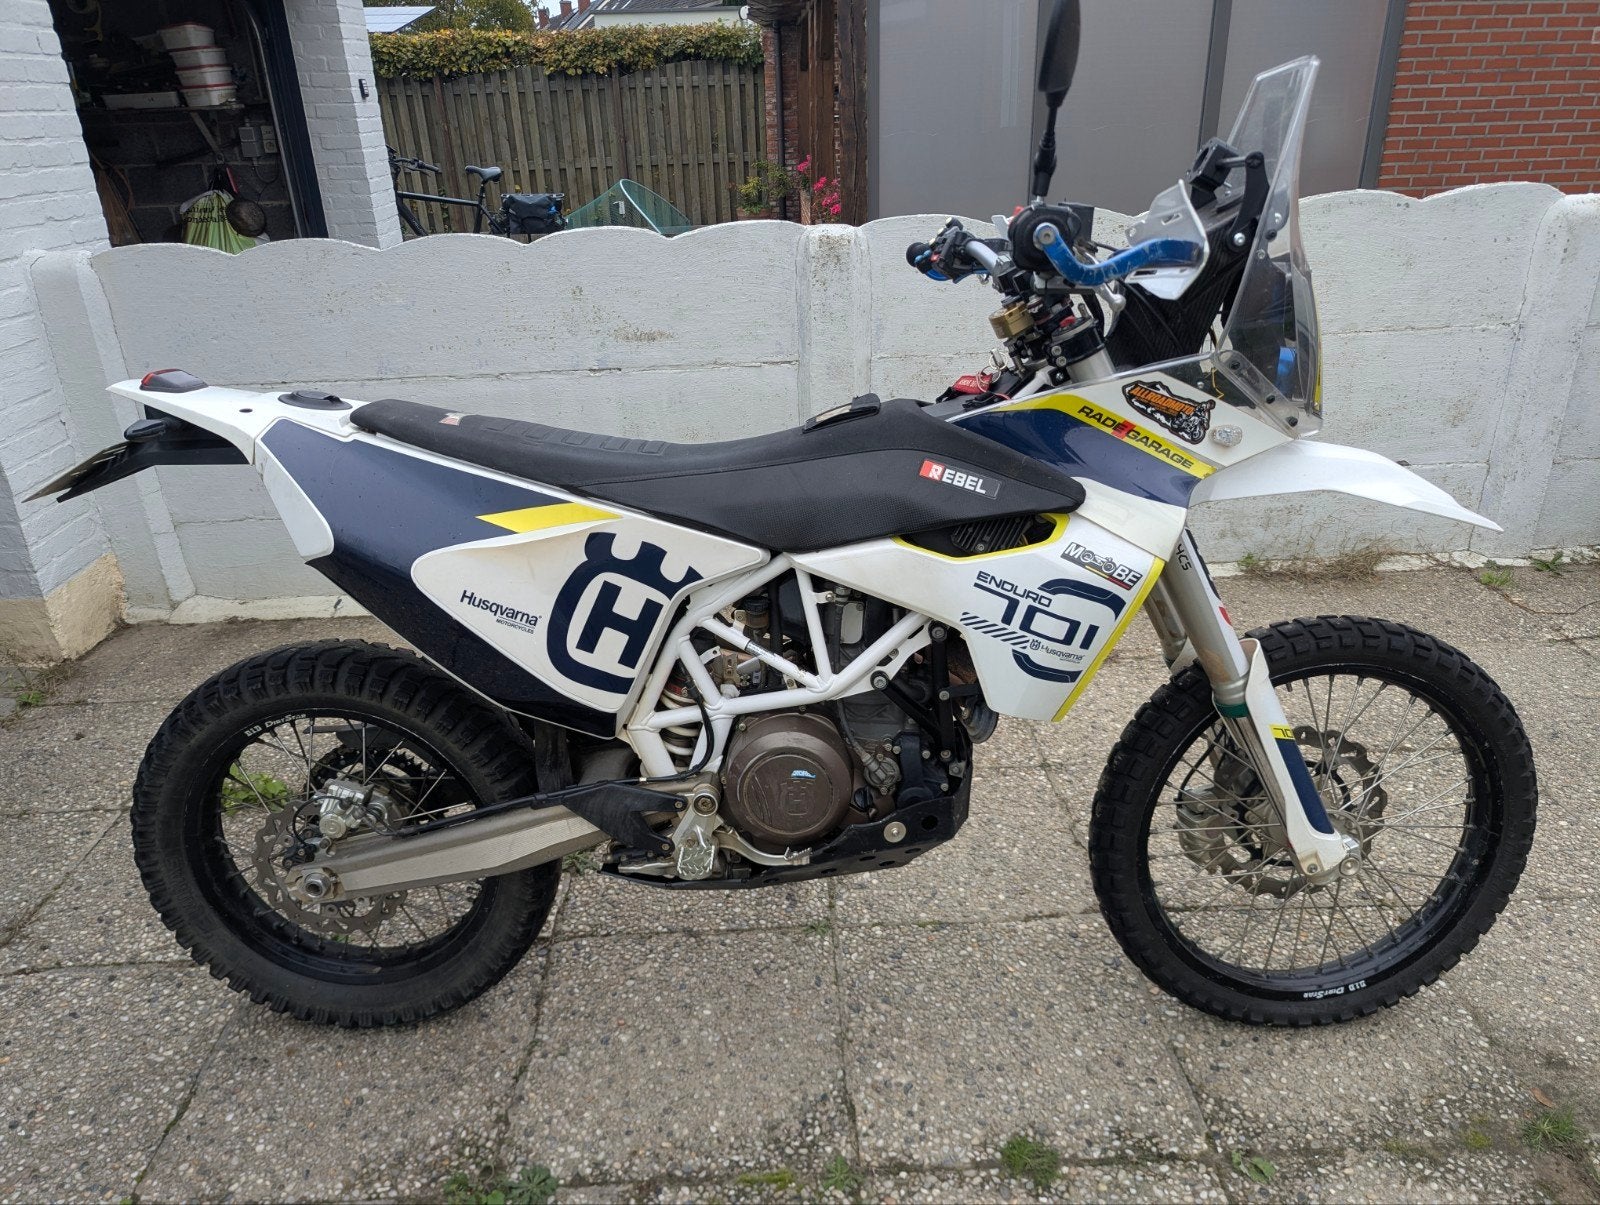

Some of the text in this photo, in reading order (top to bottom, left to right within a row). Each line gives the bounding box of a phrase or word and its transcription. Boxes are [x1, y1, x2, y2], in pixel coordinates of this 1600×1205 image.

[1129, 385, 1196, 416] ALLROADMOTO
[1077, 405, 1131, 433] RADE
[1125, 428, 1194, 469] GARAGE
[928, 463, 987, 494] REBEL
[976, 570, 1053, 608] ENDURO
[495, 618, 535, 635] MOTORCYCLES
[973, 582, 1100, 651] 701
